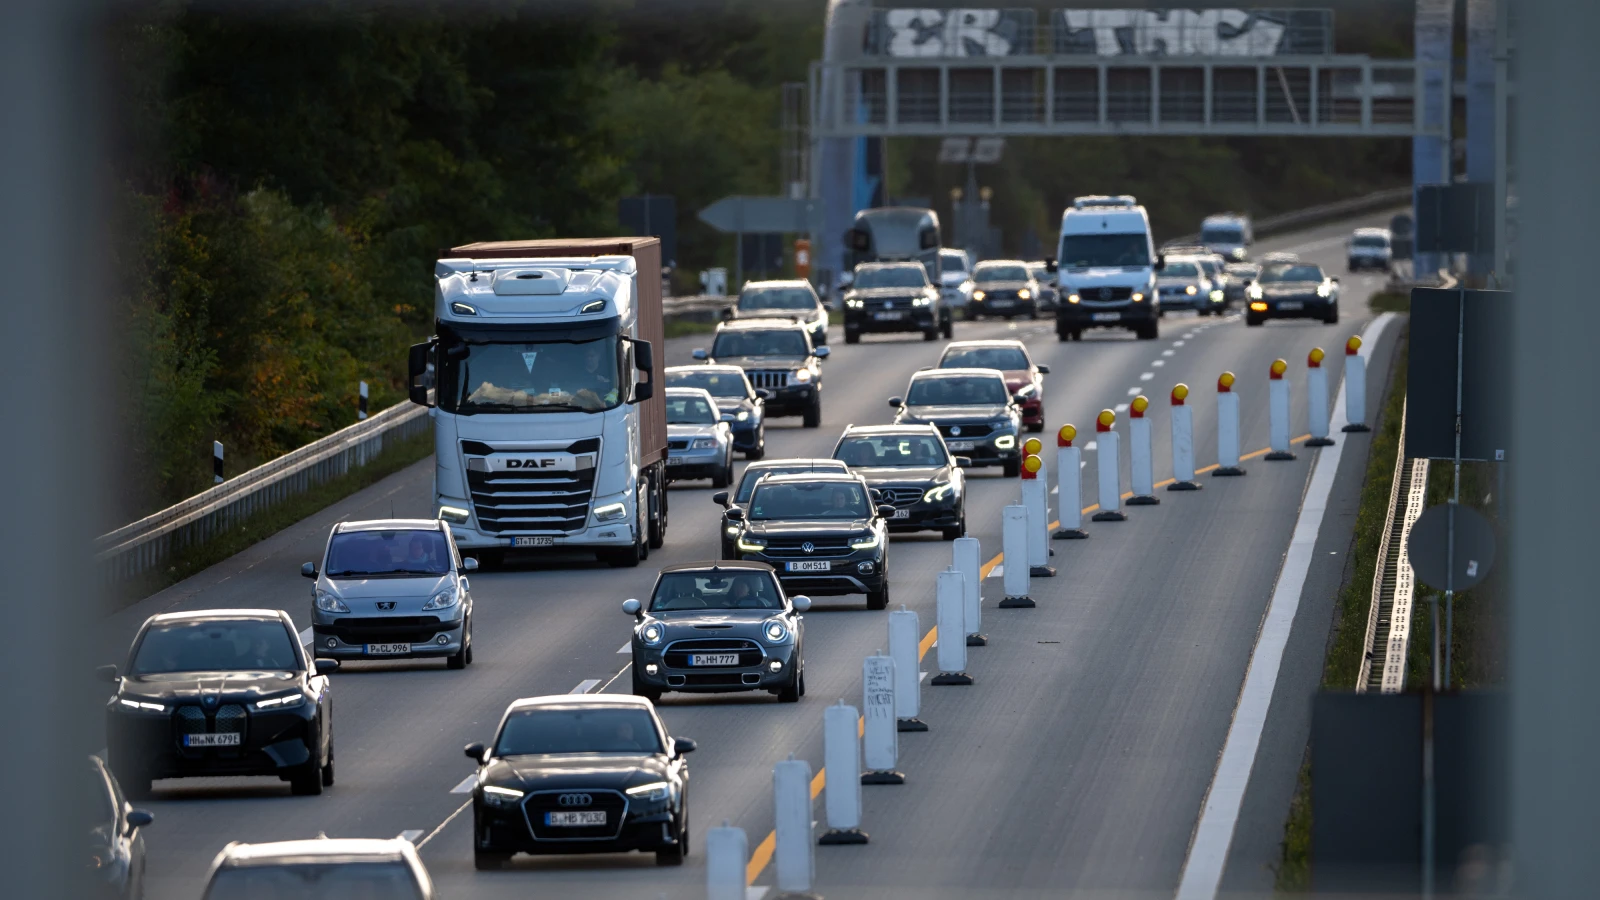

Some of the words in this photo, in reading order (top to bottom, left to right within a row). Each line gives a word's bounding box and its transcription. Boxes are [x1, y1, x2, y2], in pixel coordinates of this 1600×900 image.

[506, 458, 555, 468] DAF
[515, 537, 524, 545] GT
[792, 562, 798, 570] B
[370, 644, 376, 653] P
[380, 644, 391, 653] CL
[392, 644, 408, 653] 996
[695, 655, 702, 665] P
[706, 655, 718, 664] HH
[719, 655, 735, 664] 777
[189, 735, 200, 745] HH
[205, 735, 216, 744] NK
